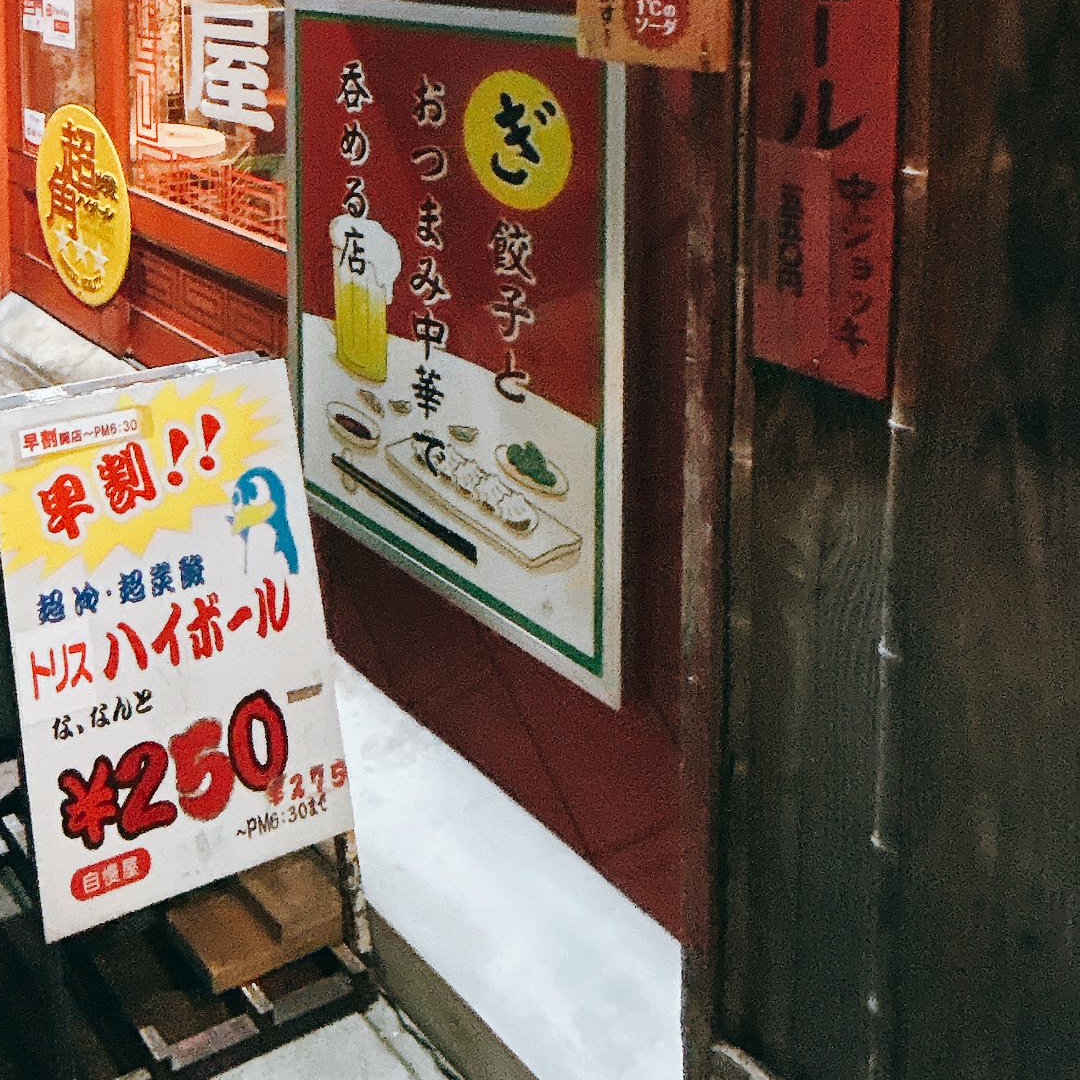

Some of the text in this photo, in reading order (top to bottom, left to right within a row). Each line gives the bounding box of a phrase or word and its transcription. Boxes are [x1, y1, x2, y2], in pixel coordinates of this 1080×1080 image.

[336, 59, 373, 276] 呑める店
[490, 91, 556, 186] ぎ
[409, 73, 451, 477] おつまみ中華で
[488, 217, 537, 405] 餃子と
[37, 413, 221, 540] 早割!!
[51, 688, 153, 741] な、なんと
[57, 688, 289, 851] ¥250
